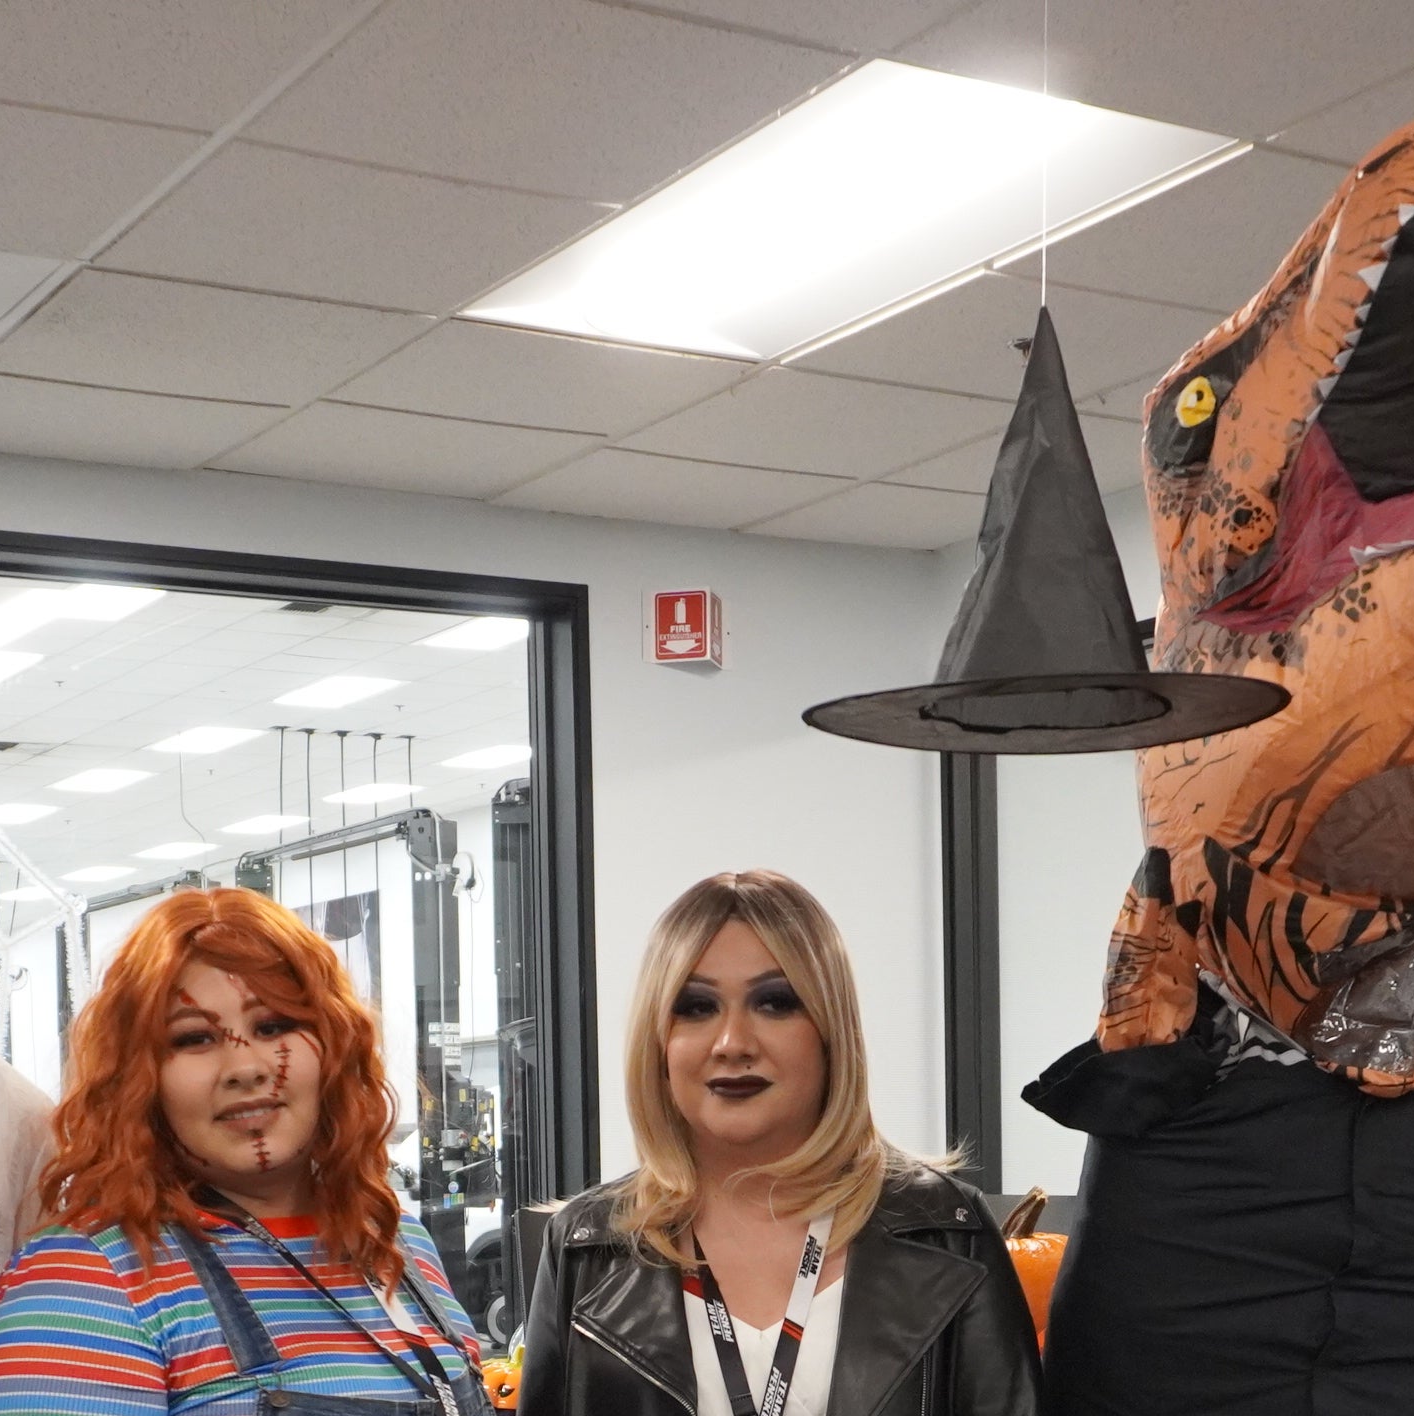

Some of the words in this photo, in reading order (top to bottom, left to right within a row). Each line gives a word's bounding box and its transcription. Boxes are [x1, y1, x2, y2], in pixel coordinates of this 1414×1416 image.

[670, 624, 691, 633] FIRE
[799, 1234, 816, 1279] PENSKE
[810, 1245, 824, 1275] TEAM
[707, 1302, 723, 1336] TEAM
[718, 1300, 735, 1343] PENSKE
